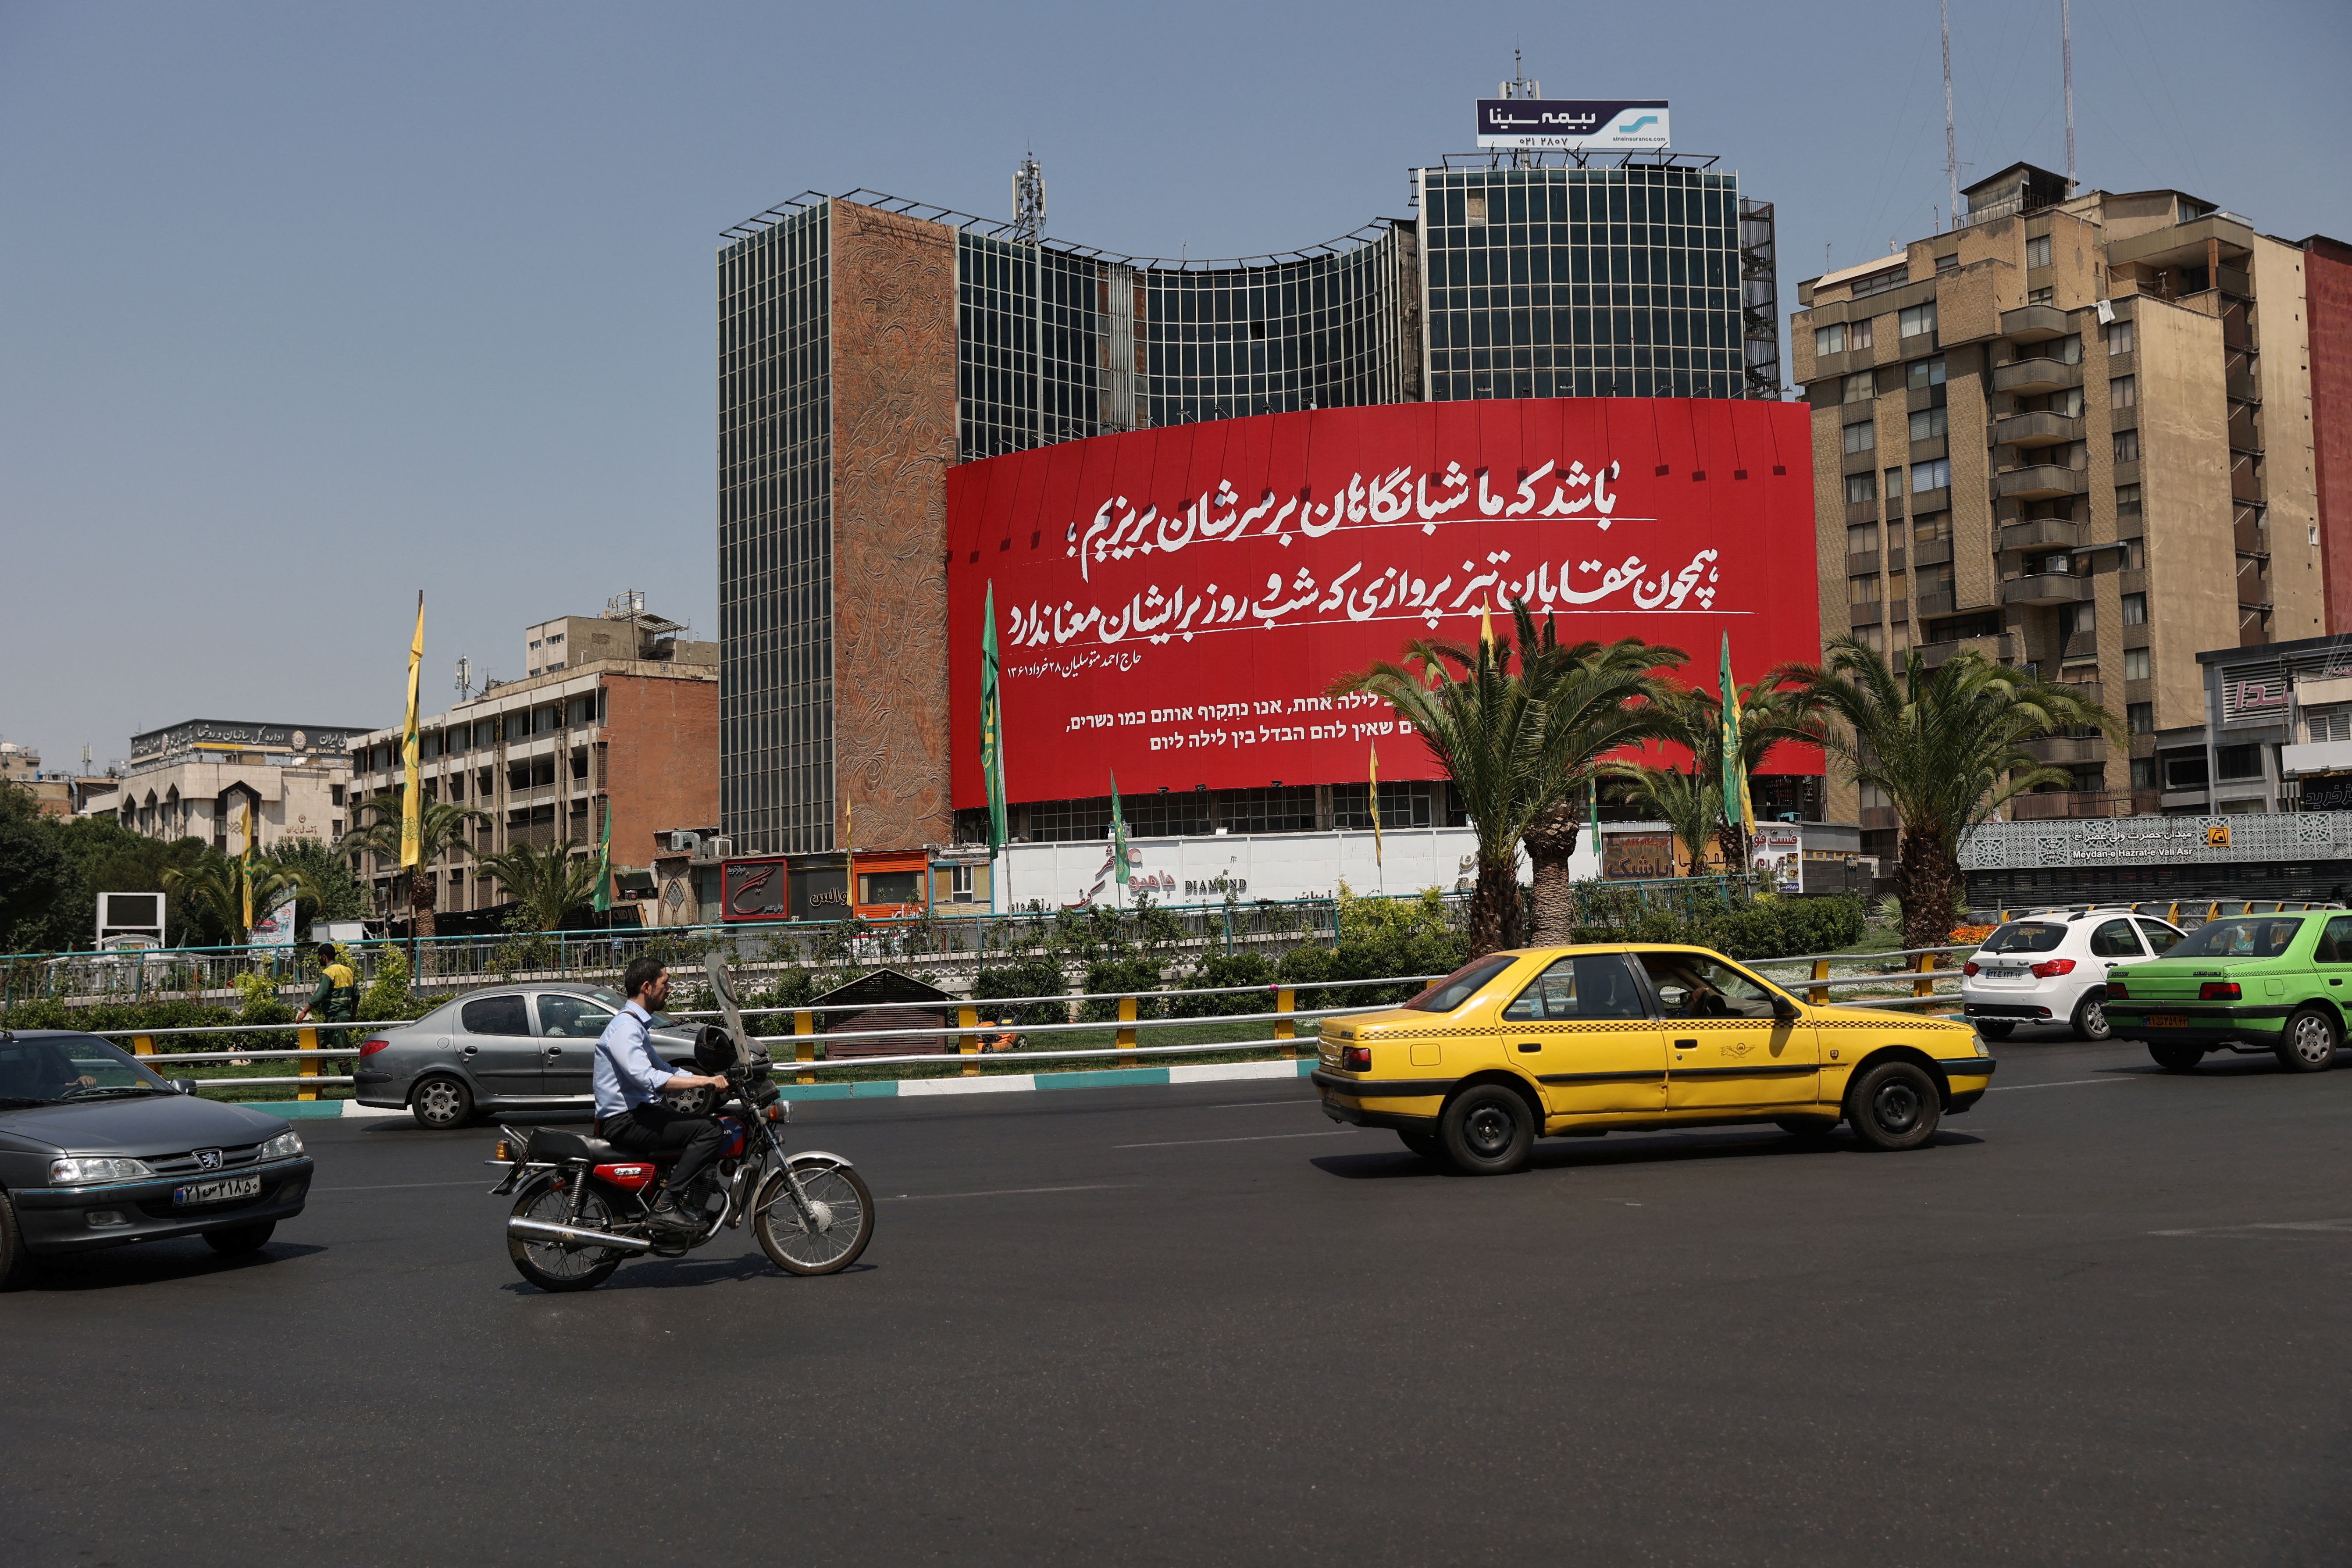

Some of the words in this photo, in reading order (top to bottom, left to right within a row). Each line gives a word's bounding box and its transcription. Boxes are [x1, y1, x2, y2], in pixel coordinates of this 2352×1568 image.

[1489, 108, 1539, 129] سینا
[1542, 112, 1596, 130] بیمه
[1519, 137, 1535, 146] ۰۲۱
[1540, 137, 1568, 146] ۲۸۰۷
[1478, 469, 1504, 517] ما
[1505, 459, 1555, 518] که
[1318, 561, 1362, 615] که
[1633, 548, 1719, 610] همچون
[1028, 657, 1048, 679] خرداد
[1049, 661, 1061, 673] ۲۸
[1062, 650, 1100, 678] متوسلیان
[1100, 652, 1119, 667] احمد
[1119, 649, 1142, 672] حاج
[1007, 664, 1028, 678] ۱۳۶۱
[1150, 706, 1194, 723] אותם
[1253, 700, 1283, 715] אנו
[1118, 711, 1146, 726] כמו
[1188, 727, 1227, 748] לילה
[1231, 730, 1256, 749] בין
[1259, 724, 1305, 743] הבדל
[1309, 720, 1347, 740] להם
[1351, 721, 1393, 742] שאין
[1150, 731, 1184, 751] ליום
[2306, 784, 2342, 809] خرید
[1753, 829, 1767, 848] فو
[1769, 829, 1798, 845] فست
[2084, 834, 2107, 843] عصر
[2109, 831, 2126, 842] ولی
[2127, 831, 2161, 842] حضرت
[2163, 830, 2192, 840] میدان
[2073, 850, 2116, 859] Meydan-e
[2118, 849, 2156, 857] Hazrat-e
[1185, 878, 1247, 891] DIAMND
